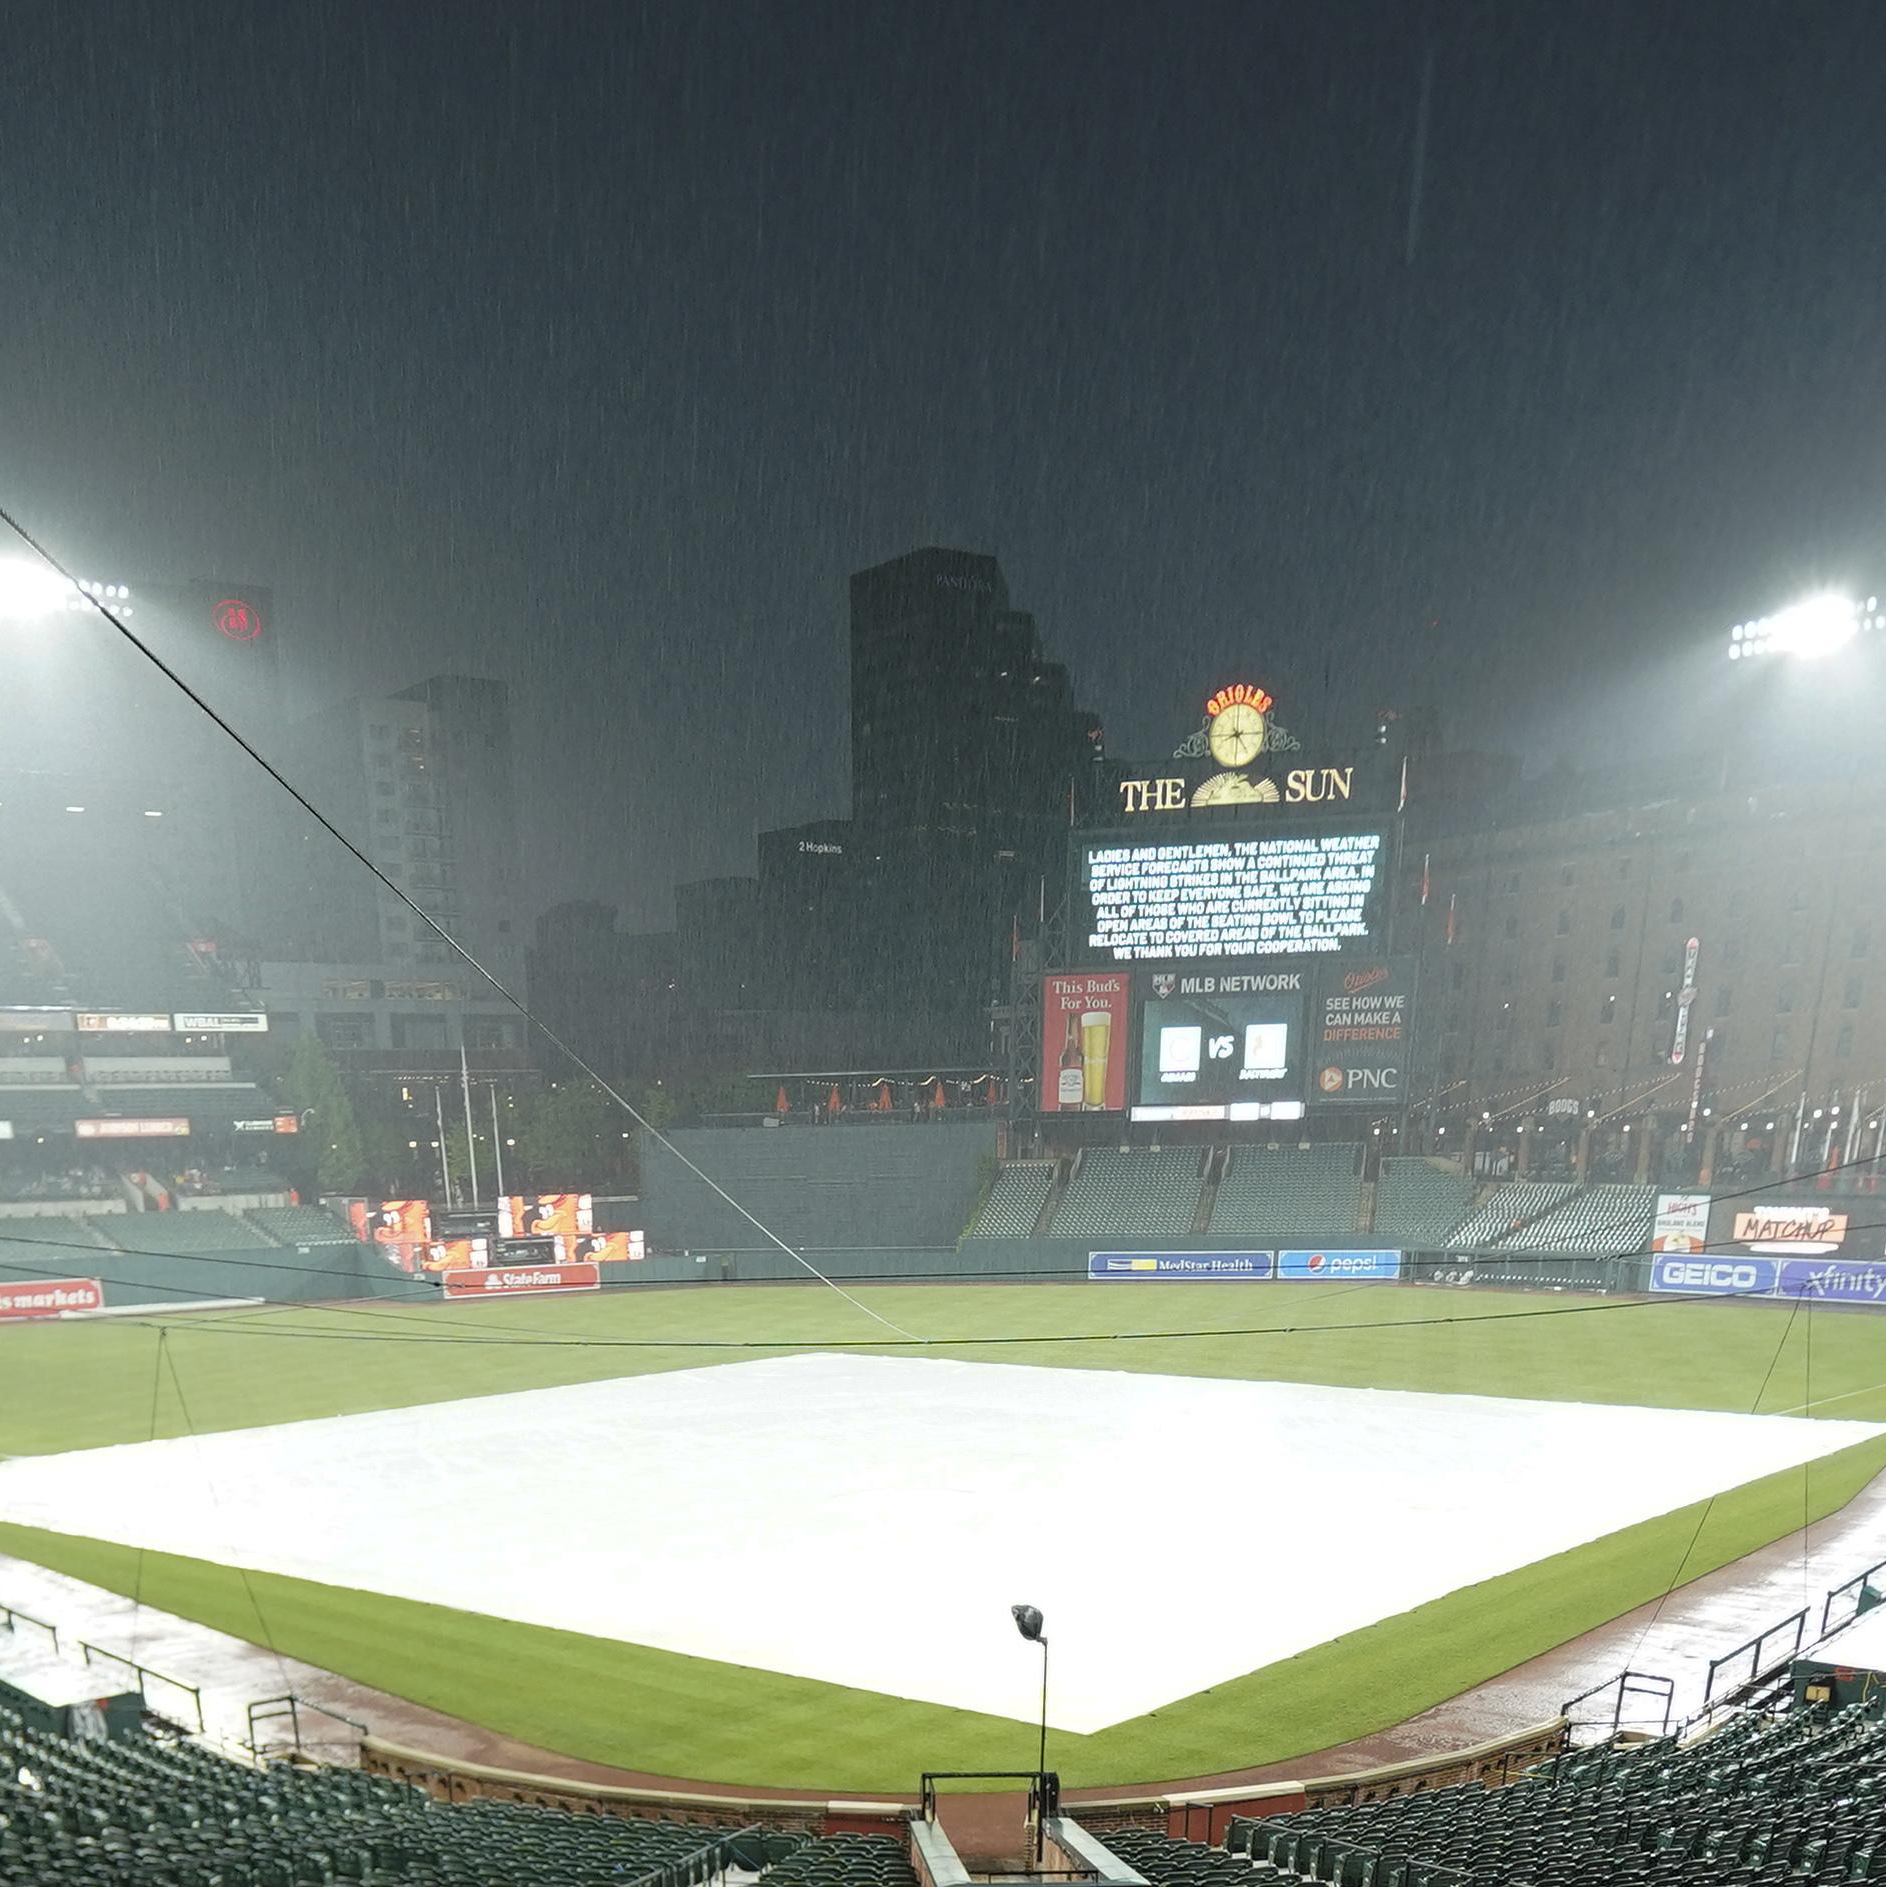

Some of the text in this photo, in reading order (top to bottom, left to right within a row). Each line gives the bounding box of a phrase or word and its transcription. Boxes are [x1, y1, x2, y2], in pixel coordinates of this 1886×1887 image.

[1206, 683, 1273, 717] ORIOLES
[1119, 767, 1353, 812] THE SUN
[1088, 848, 1130, 864] LADIES
[1132, 847, 1156, 862] AND
[1234, 842, 1258, 856] THE
[1259, 839, 1319, 854] NATIONAL
[1321, 835, 1380, 852] WEATHER
[1091, 850, 1375, 877] SERVICE FORECASTS SHOW A CONTINUED THREAT
[1089, 878, 1106, 892] OF
[1106, 875, 1168, 891] LIGHTNING
[1169, 873, 1218, 888] STRIKES
[1220, 872, 1233, 885] IN
[1234, 871, 1258, 884] THE
[1259, 867, 1322, 883] BALLPARK
[1362, 865, 1375, 878] IN
[1092, 891, 1131, 906] ORDER
[1132, 890, 1147, 903] TO
[1148, 889, 1179, 902] KEEP
[1180, 885, 1242, 901] EVERYONE
[1280, 883, 1299, 897] WE
[1300, 881, 1326, 895] ARE
[1326, 879, 1371, 894] ASKING
[1096, 894, 1364, 919] ALL OF THOSE WHO ARE CURRENTLY SITTING IN
[1097, 908, 1362, 933] OPEN AREAS OF THE SEATING BOWL TO PLEASE
[1089, 932, 1148, 947] RELOCATE
[1149, 931, 1164, 944] TO
[1165, 928, 1219, 944] COVERED
[1220, 926, 1259, 942] AREAS
[1260, 925, 1277, 939] OF
[1278, 924, 1302, 938] THE
[1113, 946, 1132, 960] WE
[1134, 945, 1174, 959] THANK
[1175, 943, 1198, 957] YOU
[1199, 942, 1222, 956] FOR
[1223, 941, 1255, 955] YOUR
[1053, 979, 1121, 994] This Bud's
[1180, 973, 1301, 994] MLB NETWORK
[1060, 995, 1112, 1010] For You.
[1326, 995, 1406, 1011] SEE HOW WE
[1325, 1011, 1402, 1026] CAN MAKE A
[1324, 1026, 1402, 1042] DIFFERENCE
[1346, 1068, 1398, 1089] PNC
[1743, 1219, 1835, 1240] MATCHUP
[1159, 1258, 1254, 1272] MedStar Health
[1330, 1255, 1377, 1274] pepsi
[1663, 1262, 1757, 1288] GEICO
[14, 1289, 95, 1309] markets
